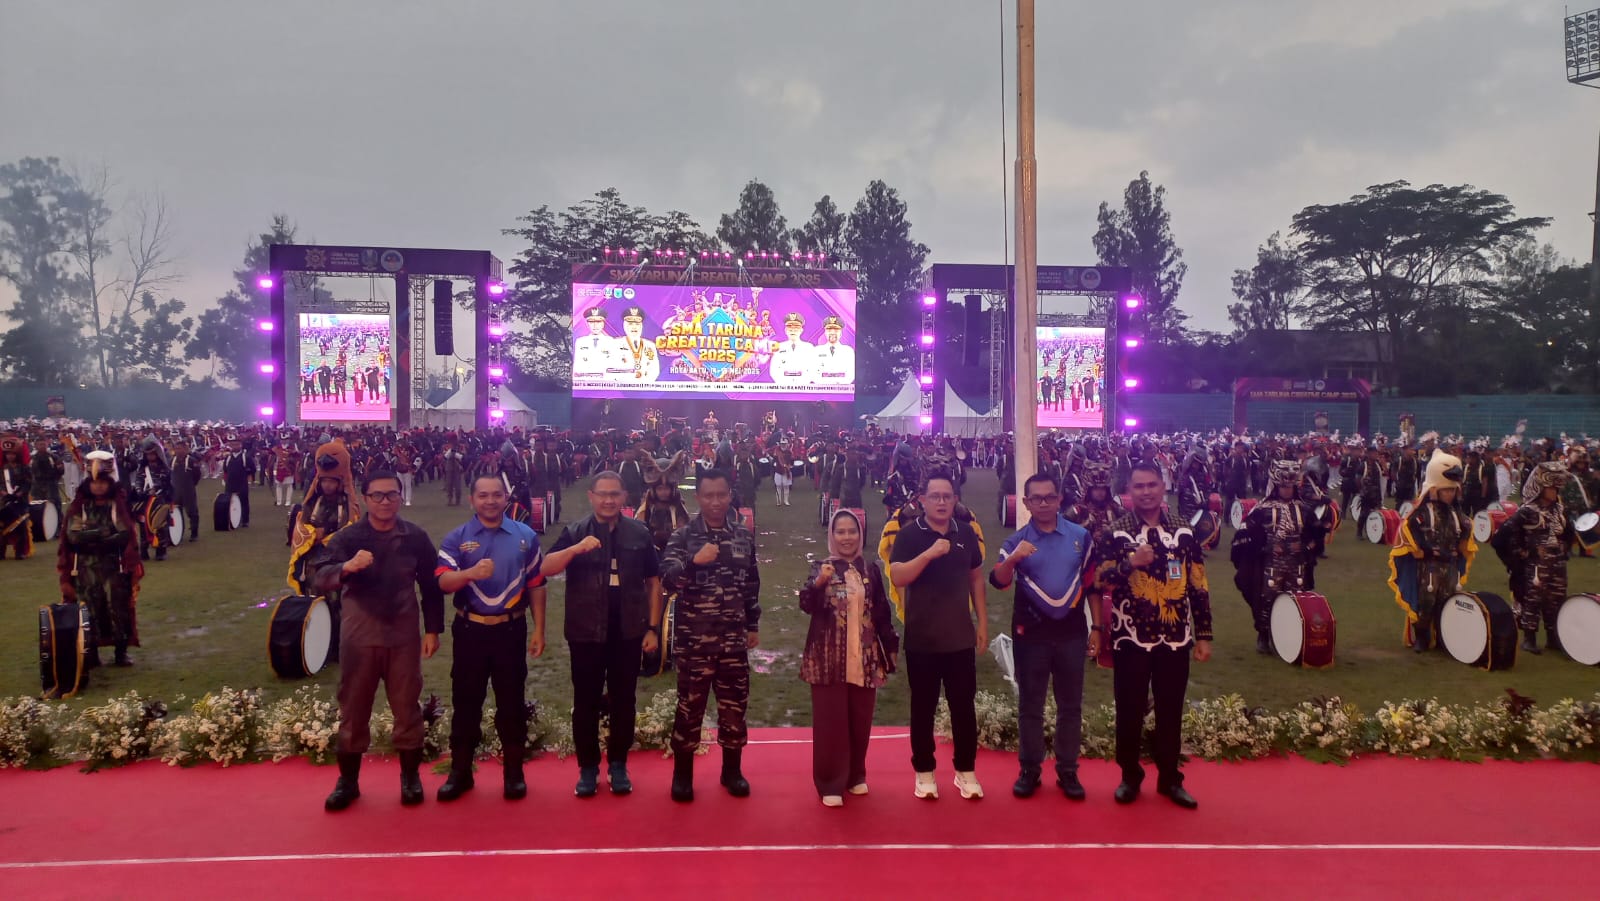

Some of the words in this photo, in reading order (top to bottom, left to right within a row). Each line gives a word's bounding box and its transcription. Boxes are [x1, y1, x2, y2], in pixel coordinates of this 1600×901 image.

[640, 270, 687, 282] TARUNA
[752, 273, 787, 284] CAMP
[671, 322, 703, 335] SMA
[707, 322, 763, 338] TARUNA
[655, 335, 731, 350] CREATIVE
[734, 338, 781, 353] CAMP
[699, 348, 736, 362] 2025
